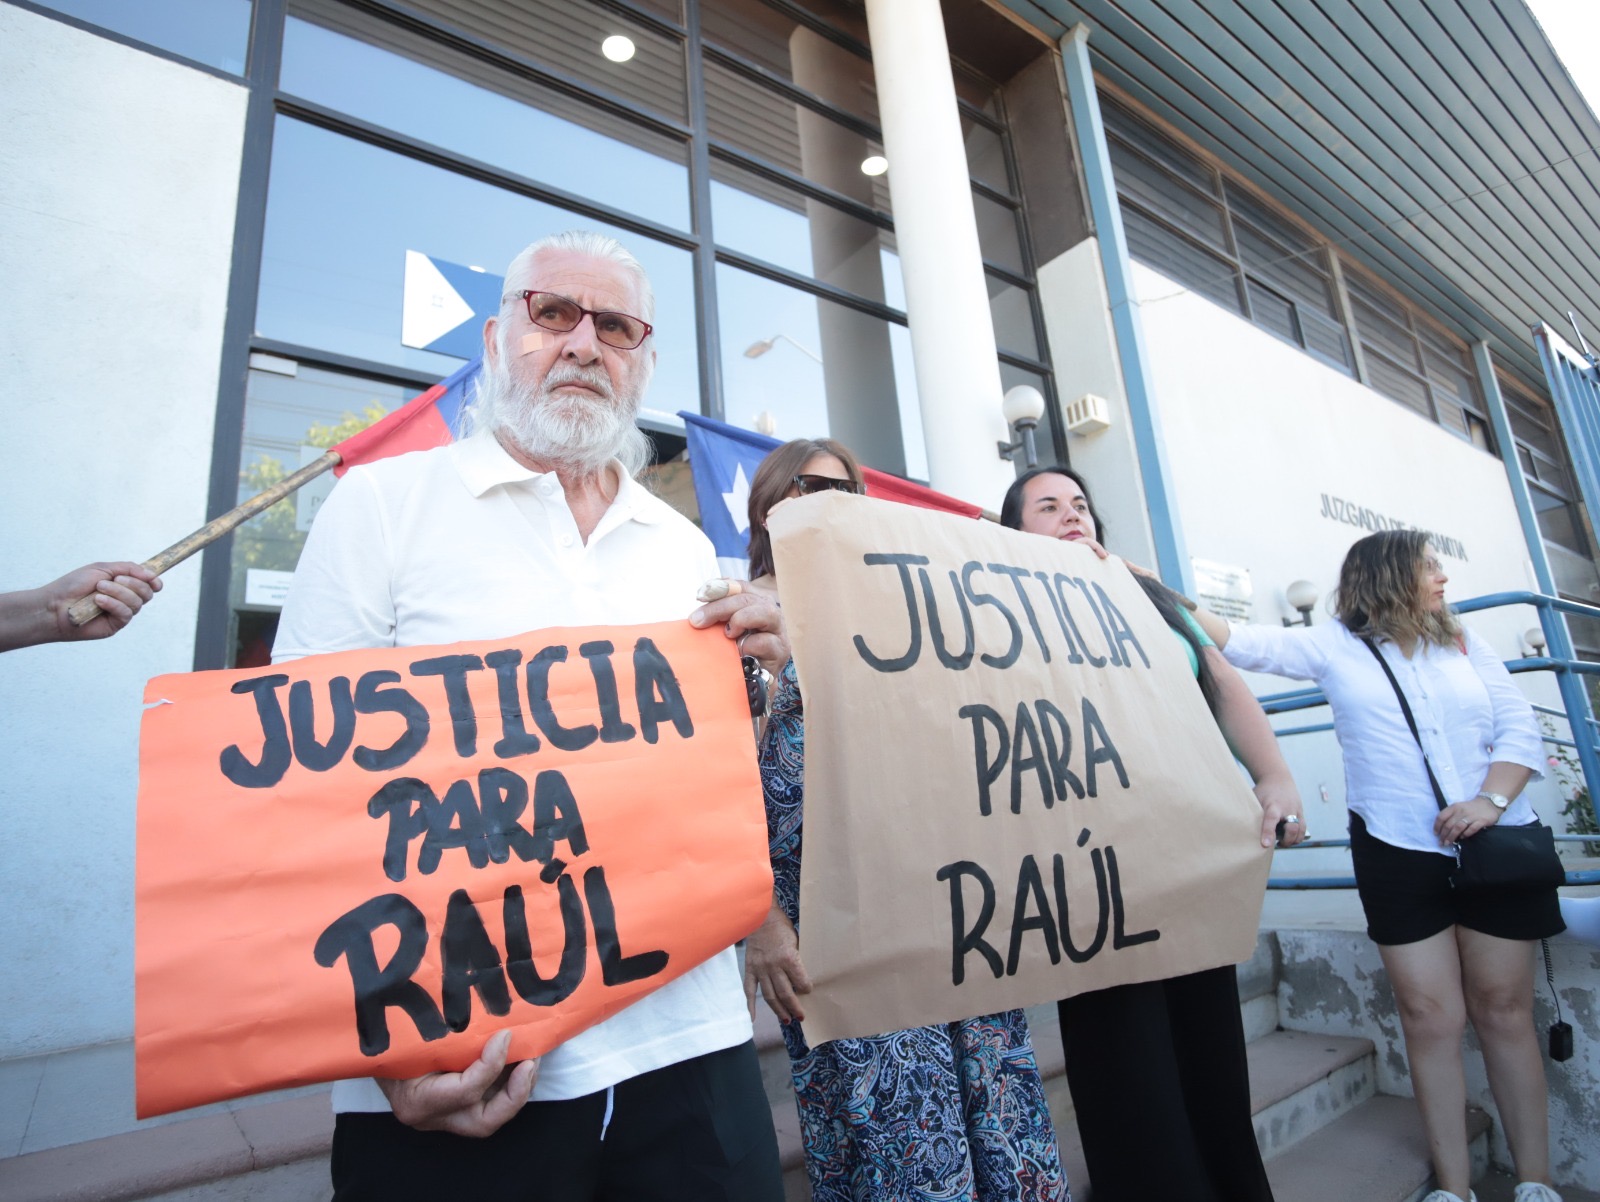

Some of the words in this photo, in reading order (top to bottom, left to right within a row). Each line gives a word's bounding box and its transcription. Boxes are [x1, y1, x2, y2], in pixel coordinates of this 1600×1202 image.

[1320, 493, 1388, 533] JUZGADO
[853, 553, 1151, 673] JUSTICIA
[219, 637, 694, 789] JUSTICIA
[958, 697, 1130, 816] PARA
[367, 767, 590, 882] PARA
[313, 858, 669, 1057] RAÚL
[936, 828, 1160, 986] RAÚL
